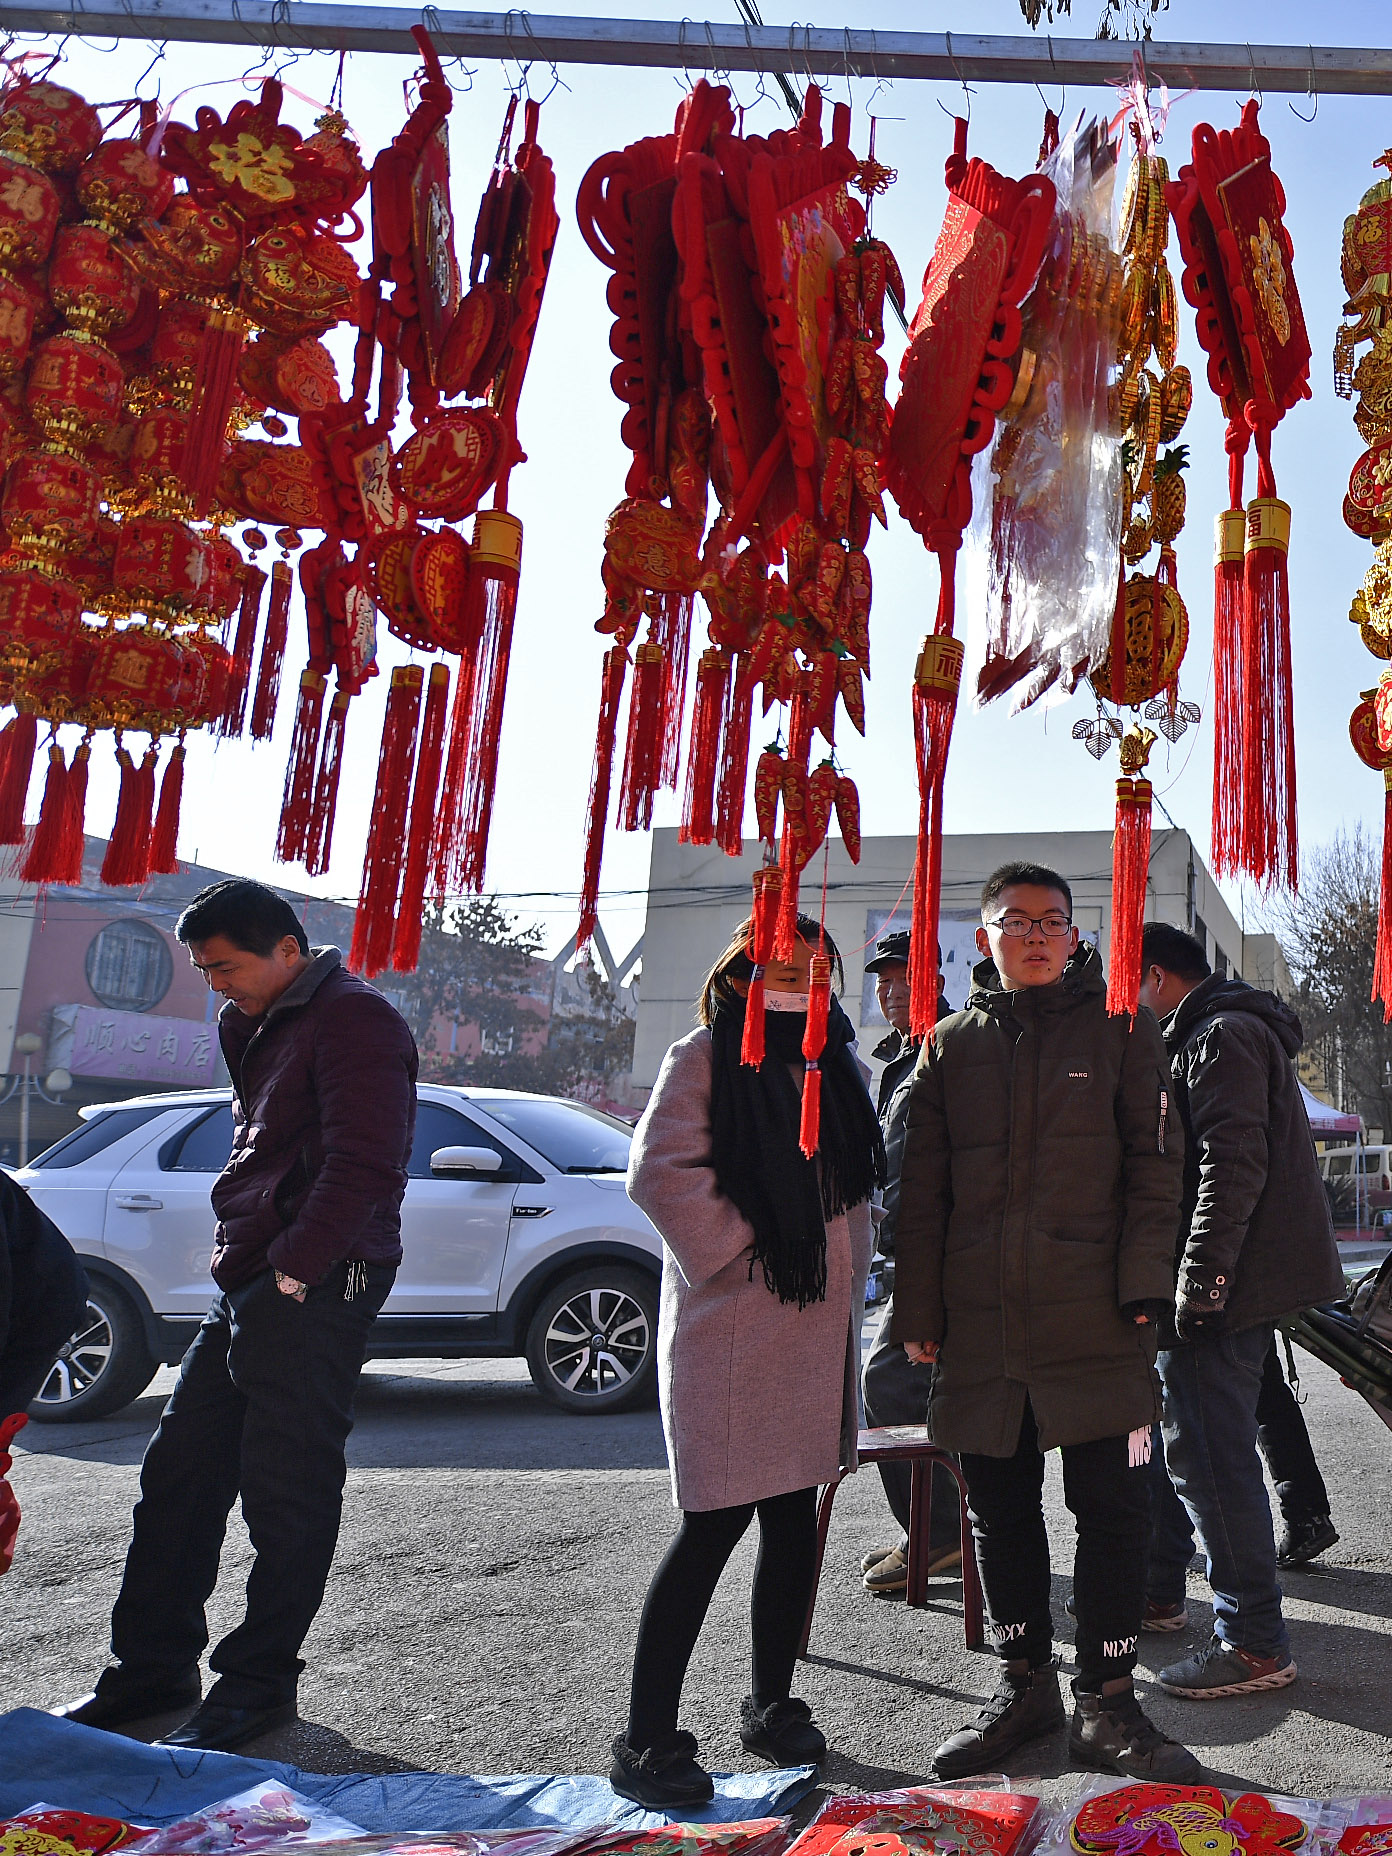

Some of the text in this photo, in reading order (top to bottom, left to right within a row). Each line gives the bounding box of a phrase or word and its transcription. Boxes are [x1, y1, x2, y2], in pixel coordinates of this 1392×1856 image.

[209, 133, 294, 203] 福
[1357, 218, 1383, 244] 福
[637, 543, 672, 578] 意
[83, 1021, 212, 1068] 顺心肉店
[1103, 1635, 1138, 1658] NIXX
